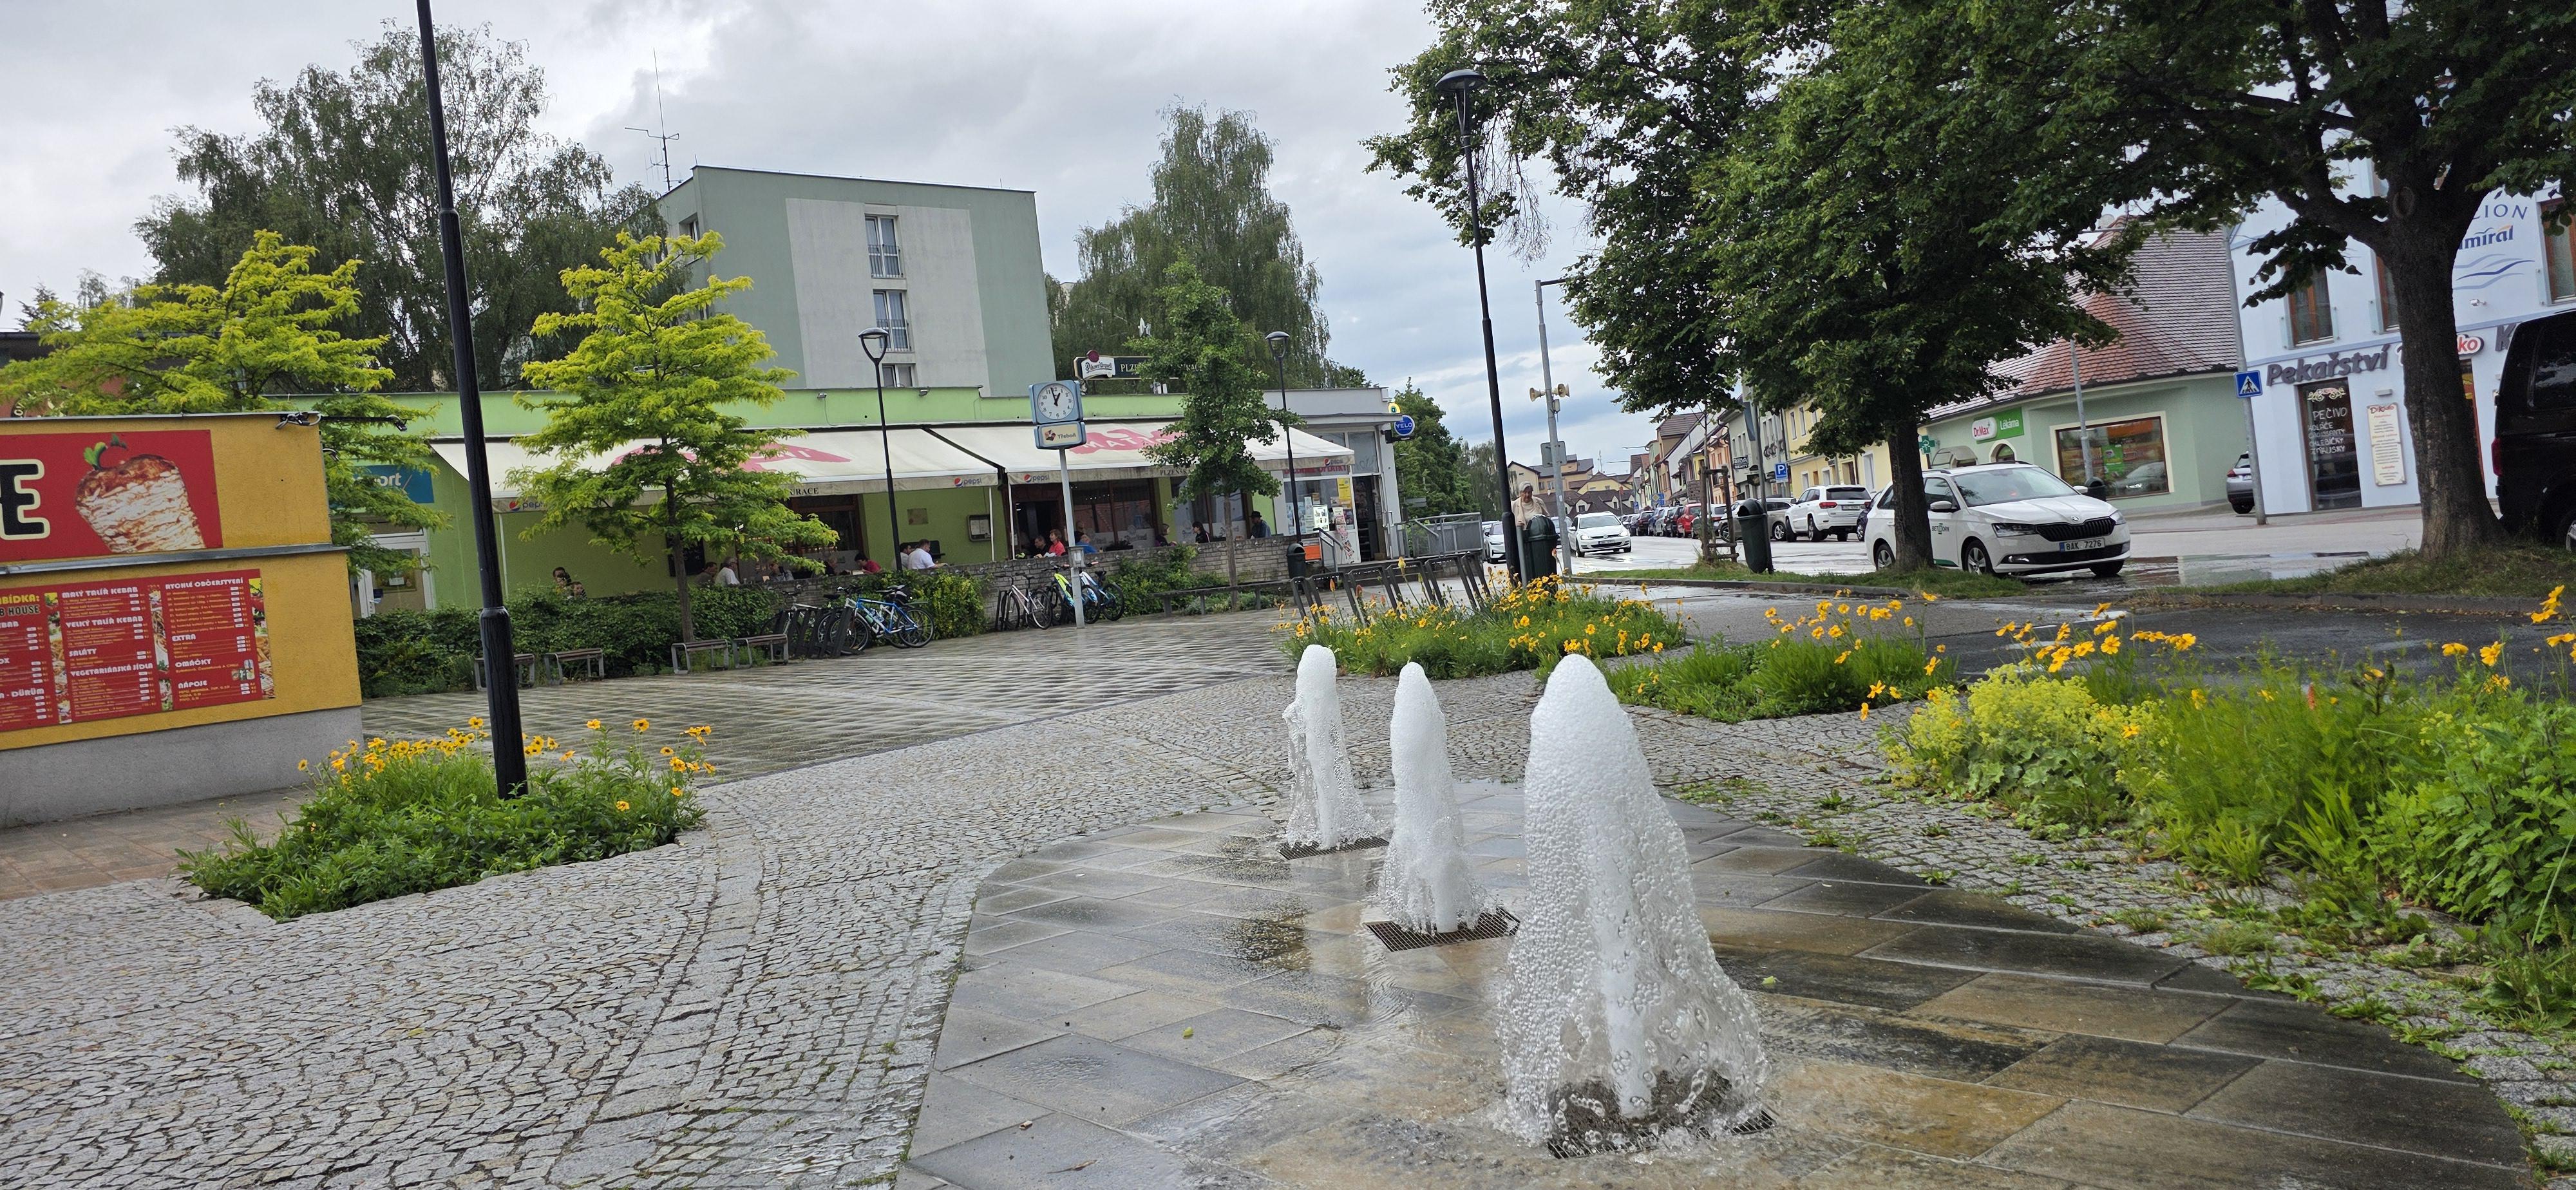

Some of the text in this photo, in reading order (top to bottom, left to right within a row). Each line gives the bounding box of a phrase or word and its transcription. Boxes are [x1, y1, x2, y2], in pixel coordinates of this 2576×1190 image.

[2472, 204, 2528, 220] ION
[2458, 225, 2514, 250] miral
[2266, 343, 2391, 386] Pekařství
[2313, 407, 2347, 420] PEČIVO
[2000, 418, 2020, 430] Lékárna
[1973, 425, 1989, 437] Dr.Max
[1777, 464, 1785, 475] P
[1032, 474, 1050, 482] pepsi
[2066, 542, 2079, 551] 8AK
[165, 577, 243, 590] RYCHLÉ OBČERSTVENÍ
[62, 589, 84, 598] MALÝ
[85, 587, 109, 596] TALÍŘ
[0, 594, 40, 605] BÍDKA:
[8, 605, 40, 616] HOUSE
[66, 616, 144, 628] VELKÝ TALÍŘ KEBAB
[172, 634, 196, 642] EXTRA
[69, 648, 97, 657] SALÁTY
[175, 658, 212, 668] OMÁČKY
[70, 665, 132, 677] VEGETARIÁNSKÁ
[178, 680, 207, 689] NÁPOJE
[11, 688, 44, 697] DÜRÜM
